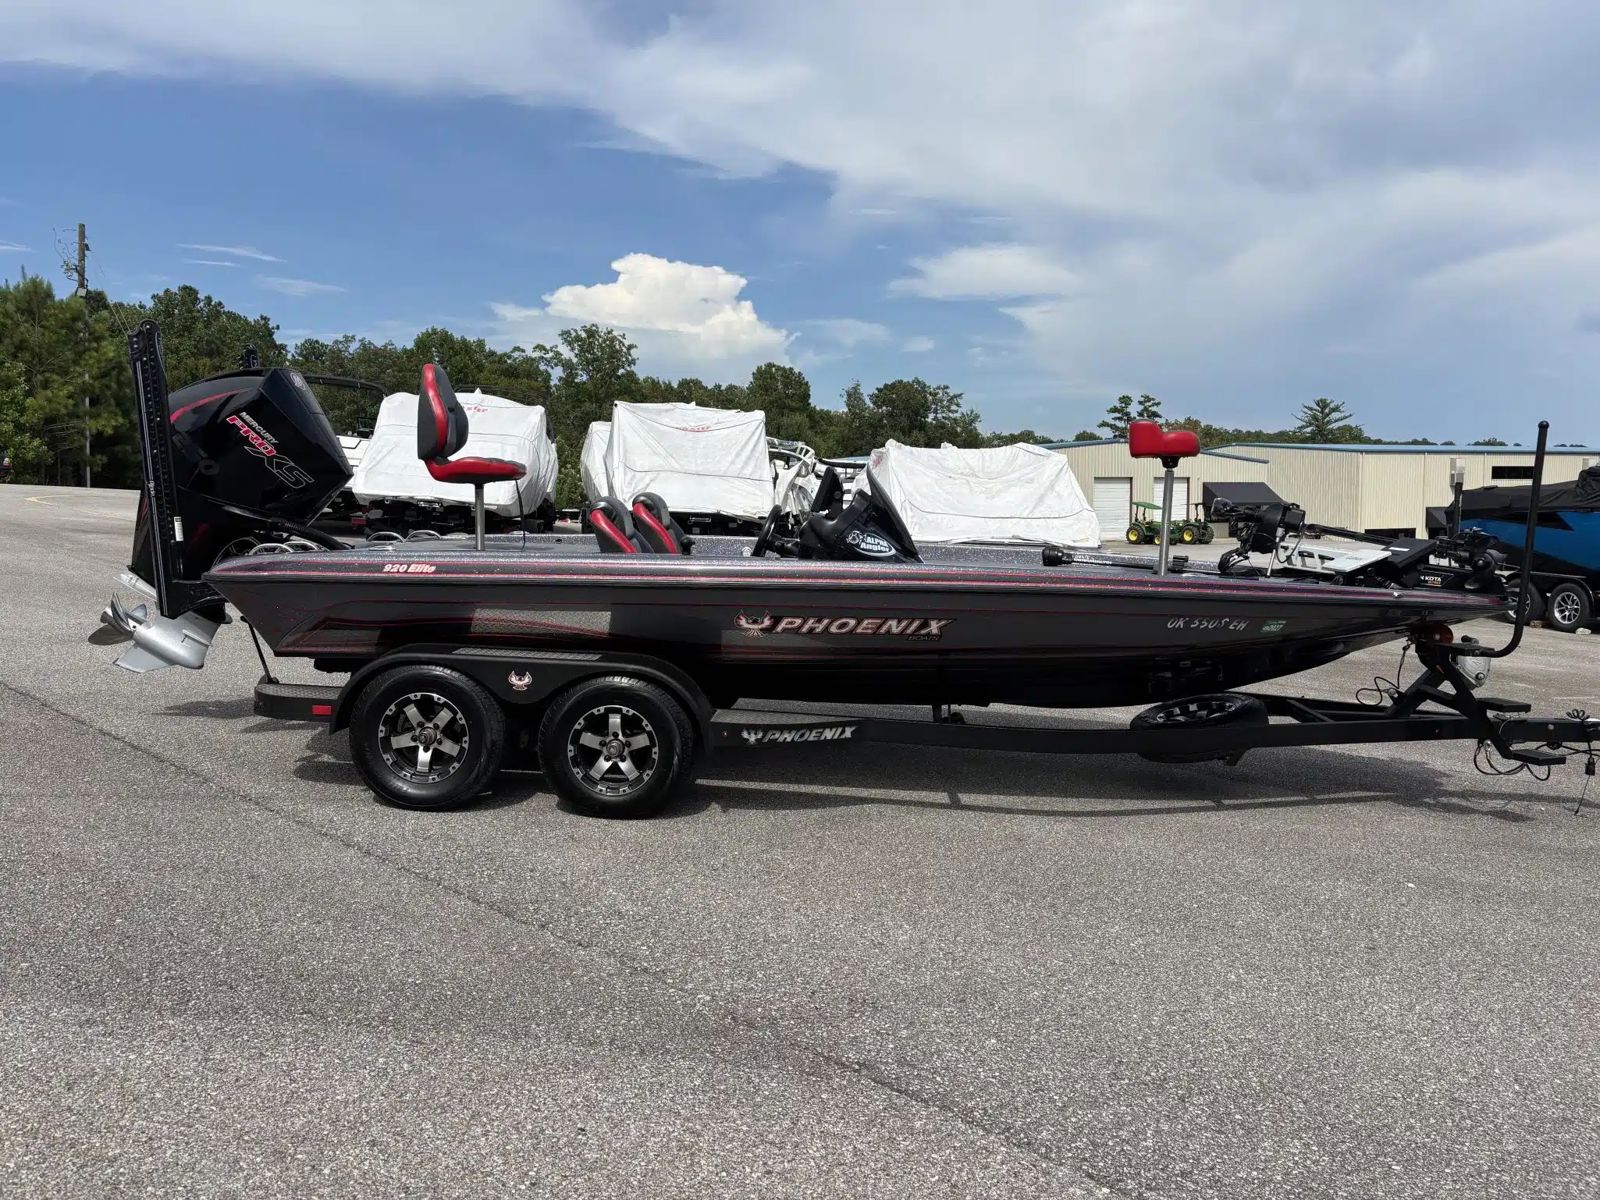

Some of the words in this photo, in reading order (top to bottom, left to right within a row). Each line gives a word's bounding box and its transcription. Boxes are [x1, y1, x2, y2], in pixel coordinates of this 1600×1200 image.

[226, 415, 276, 456] PRO
[240, 411, 279, 444] MERCURY
[243, 446, 315, 489] XS
[866, 536, 889, 548] ALPHA
[383, 563, 408, 573] 920
[407, 563, 437, 574] Elite
[773, 616, 951, 635] PHOENIX
[762, 726, 857, 742] PHOENIX
